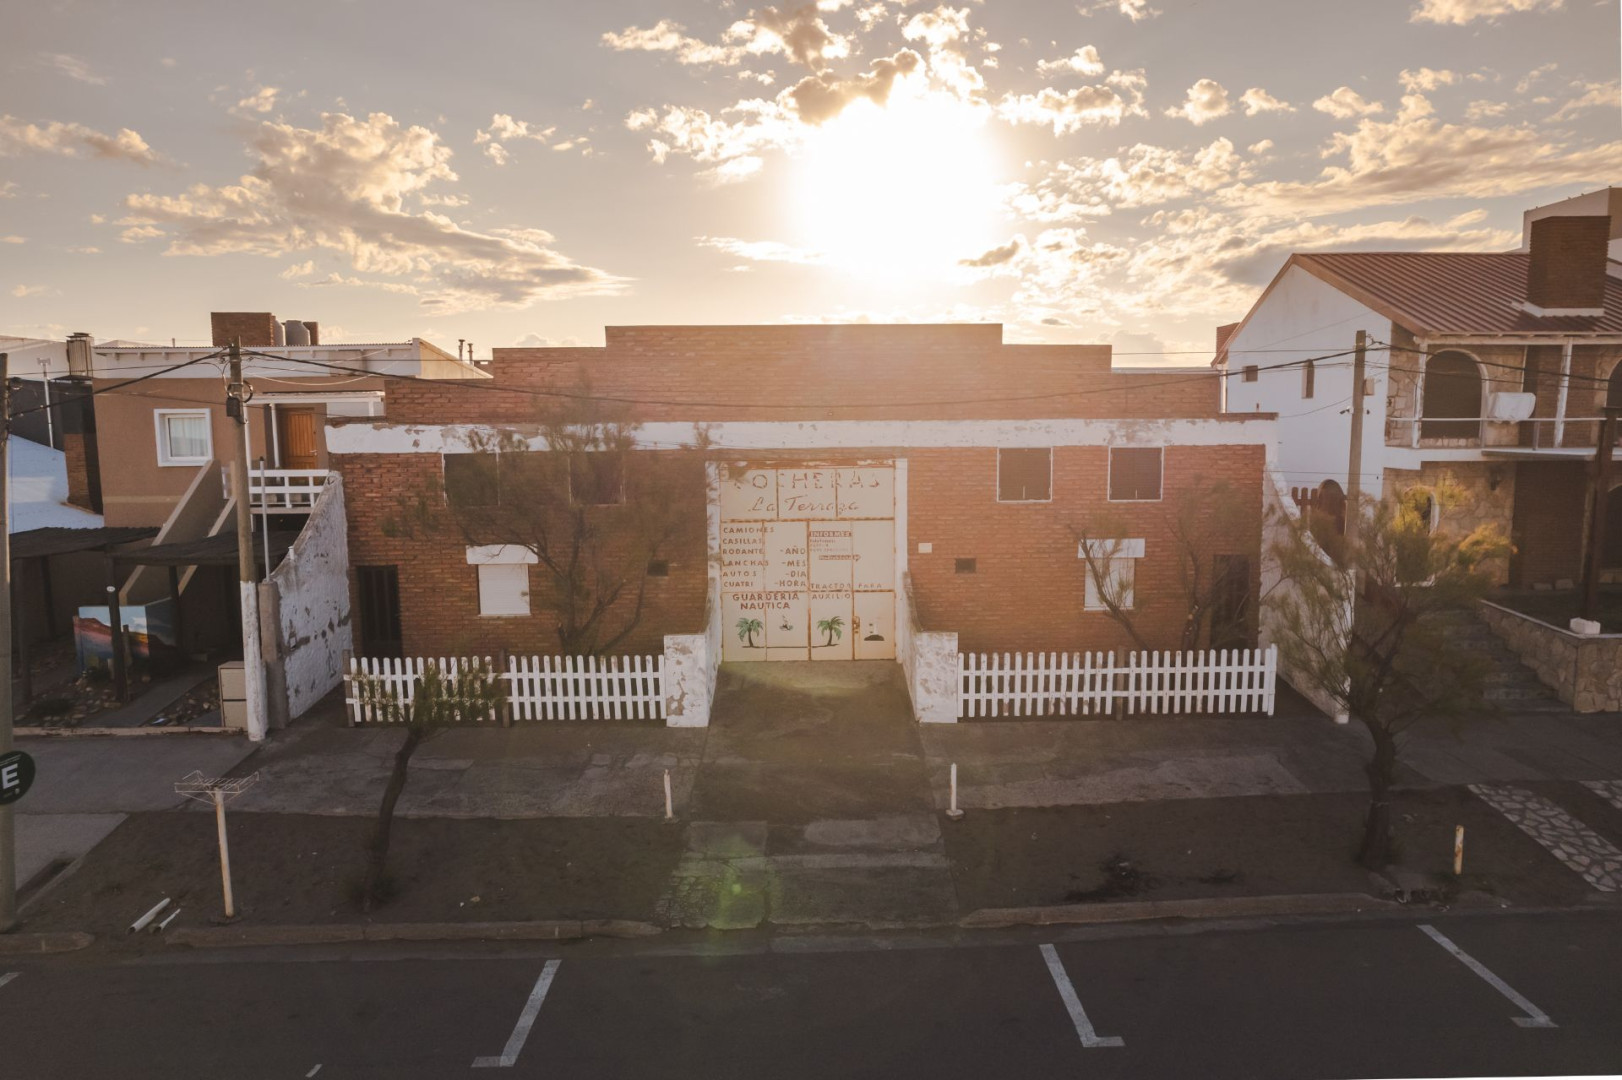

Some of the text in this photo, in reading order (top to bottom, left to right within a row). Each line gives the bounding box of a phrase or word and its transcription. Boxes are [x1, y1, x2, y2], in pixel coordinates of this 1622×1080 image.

[733, 470, 880, 489] OCHERAS
[723, 526, 775, 534] CAMIONES
[732, 591, 800, 601] GUARDERIA
[740, 601, 791, 610] NAUTICA
